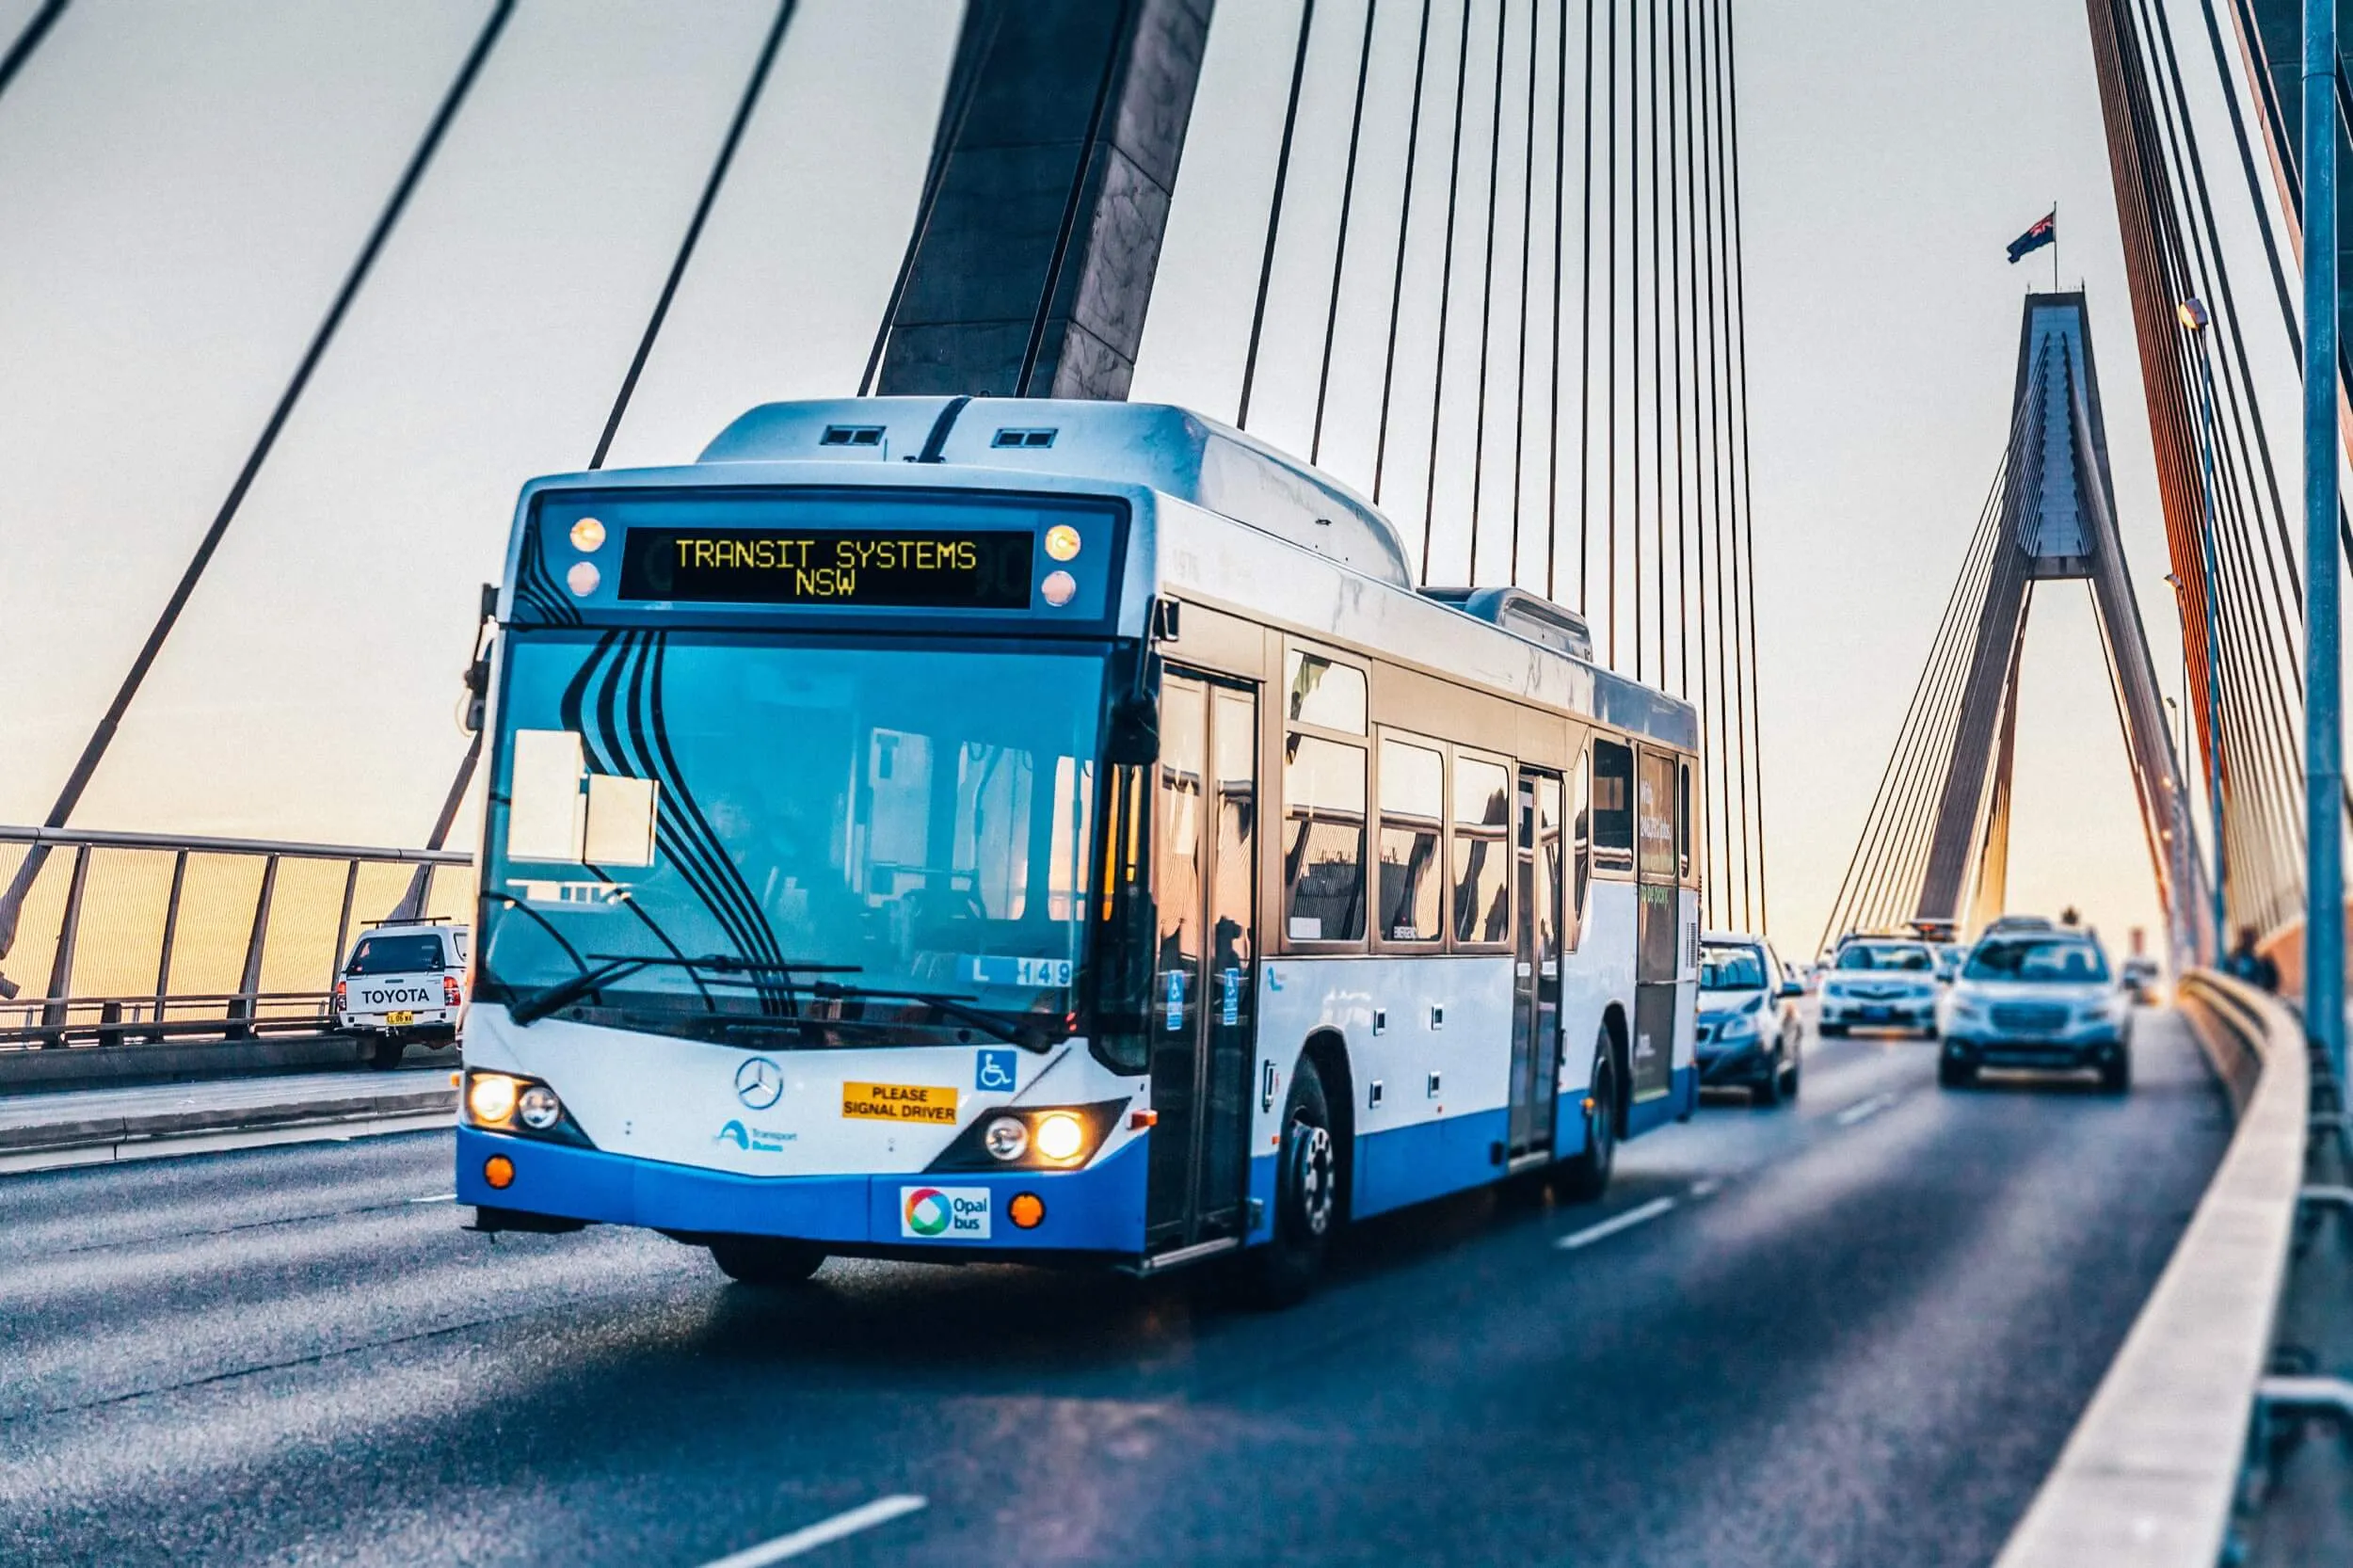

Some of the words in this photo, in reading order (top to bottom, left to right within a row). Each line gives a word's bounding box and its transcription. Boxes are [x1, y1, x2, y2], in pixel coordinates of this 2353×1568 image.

[676, 539, 815, 568] TRANSIT
[836, 540, 978, 569] SYSTEMS
[795, 569, 856, 596] NSW
[972, 958, 989, 982] L
[1023, 960, 1070, 985] 149
[361, 988, 429, 1004] TOYOTA
[872, 1086, 928, 1102] PLEASE
[843, 1100, 897, 1117] SIGNAL
[901, 1104, 955, 1120] DRIVER
[753, 1128, 798, 1142] Transport
[954, 1197, 987, 1216] Opal
[954, 1214, 981, 1230] bus
